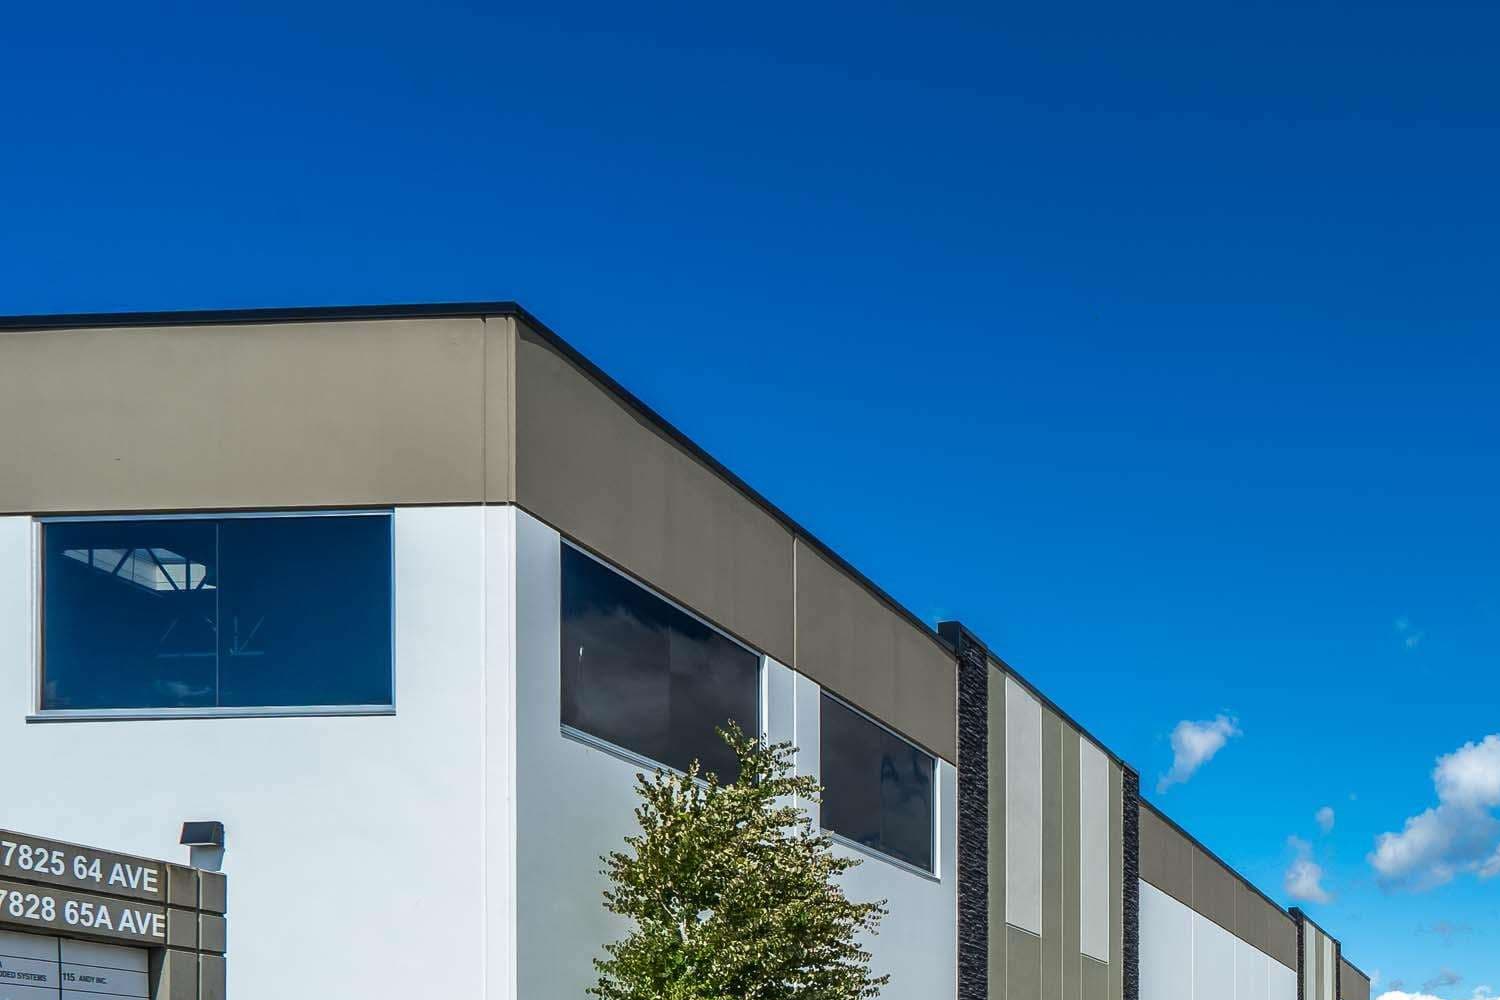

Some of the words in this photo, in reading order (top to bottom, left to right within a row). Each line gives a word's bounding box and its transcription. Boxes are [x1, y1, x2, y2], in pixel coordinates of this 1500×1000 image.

[73, 856, 102, 882] 64
[109, 863, 158, 892] AVE
[64, 900, 113, 929] 65A
[118, 909, 166, 937] AVE
[63, 973, 75, 982] 115
